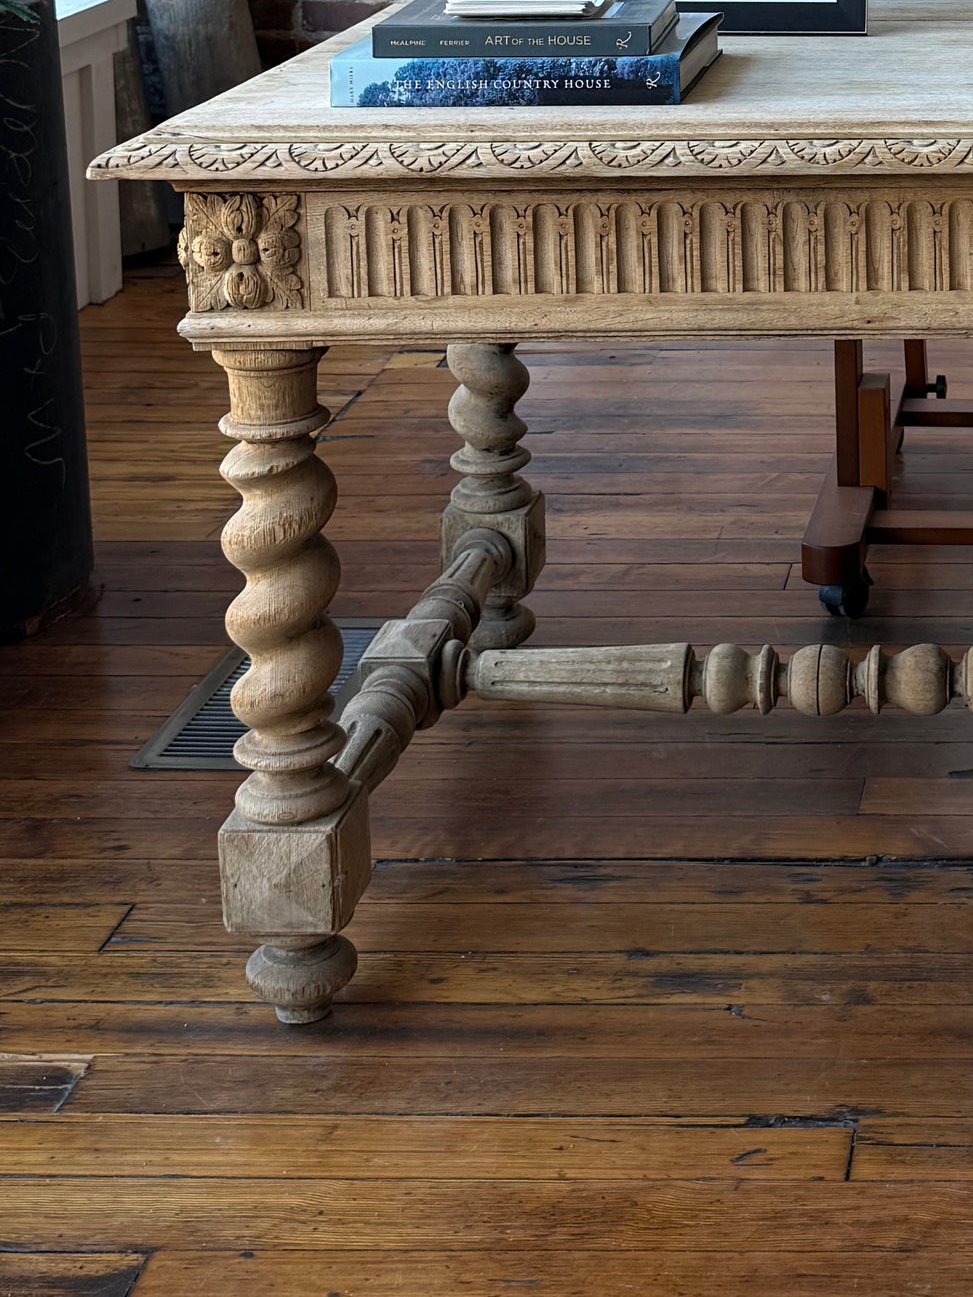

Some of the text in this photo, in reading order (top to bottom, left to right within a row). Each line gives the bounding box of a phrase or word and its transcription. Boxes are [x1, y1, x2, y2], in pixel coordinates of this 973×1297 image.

[485, 35, 592, 46] ART OF THE HOUSE
[396, 79, 612, 90] THE ENGLISH COUNTRY HOUSE
